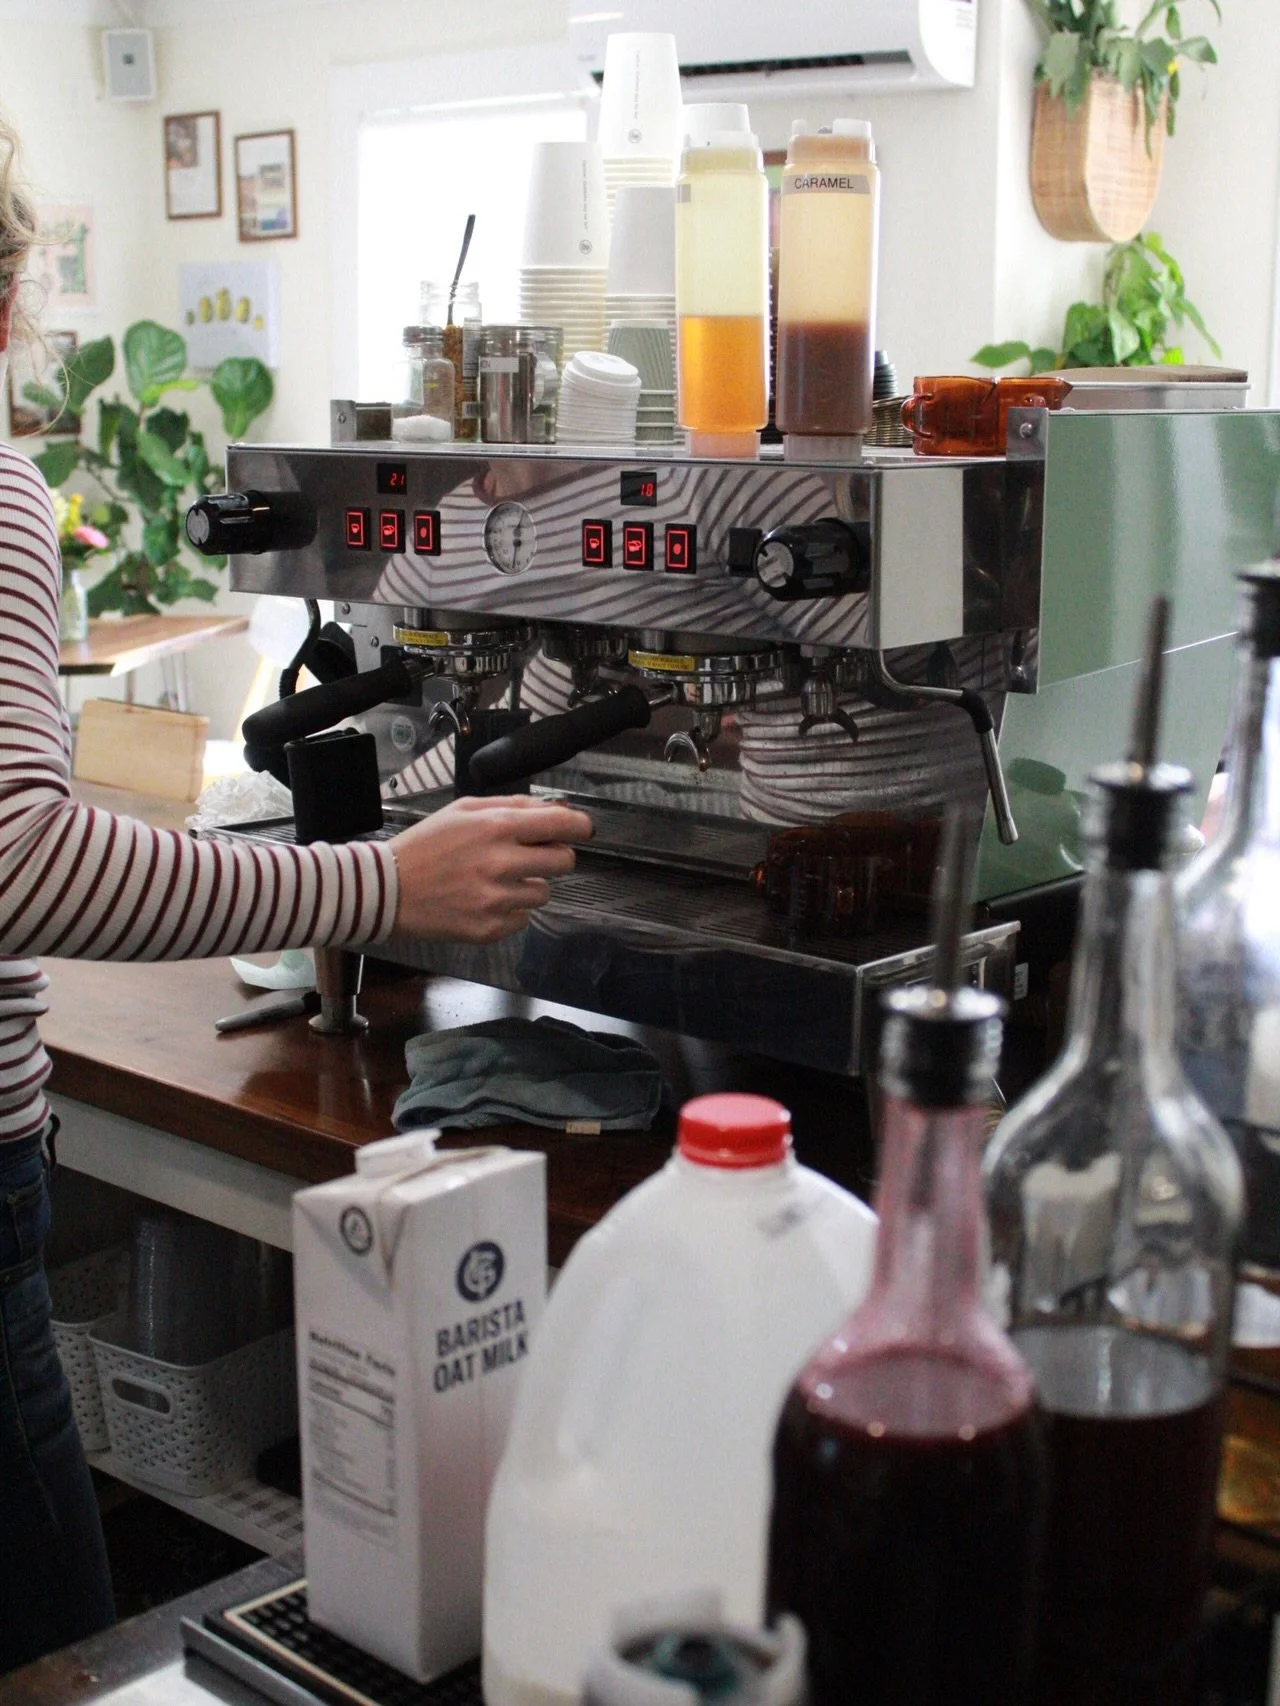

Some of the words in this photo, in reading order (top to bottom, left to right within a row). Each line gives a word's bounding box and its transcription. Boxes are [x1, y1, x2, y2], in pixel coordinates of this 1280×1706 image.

[794, 177, 854, 189] CARAMEL
[390, 472, 405, 486] 21
[640, 482, 654, 497] 18
[436, 1299, 525, 1358] BARISTA
[433, 1352, 475, 1393] OAT
[480, 1330, 529, 1375] MILK
